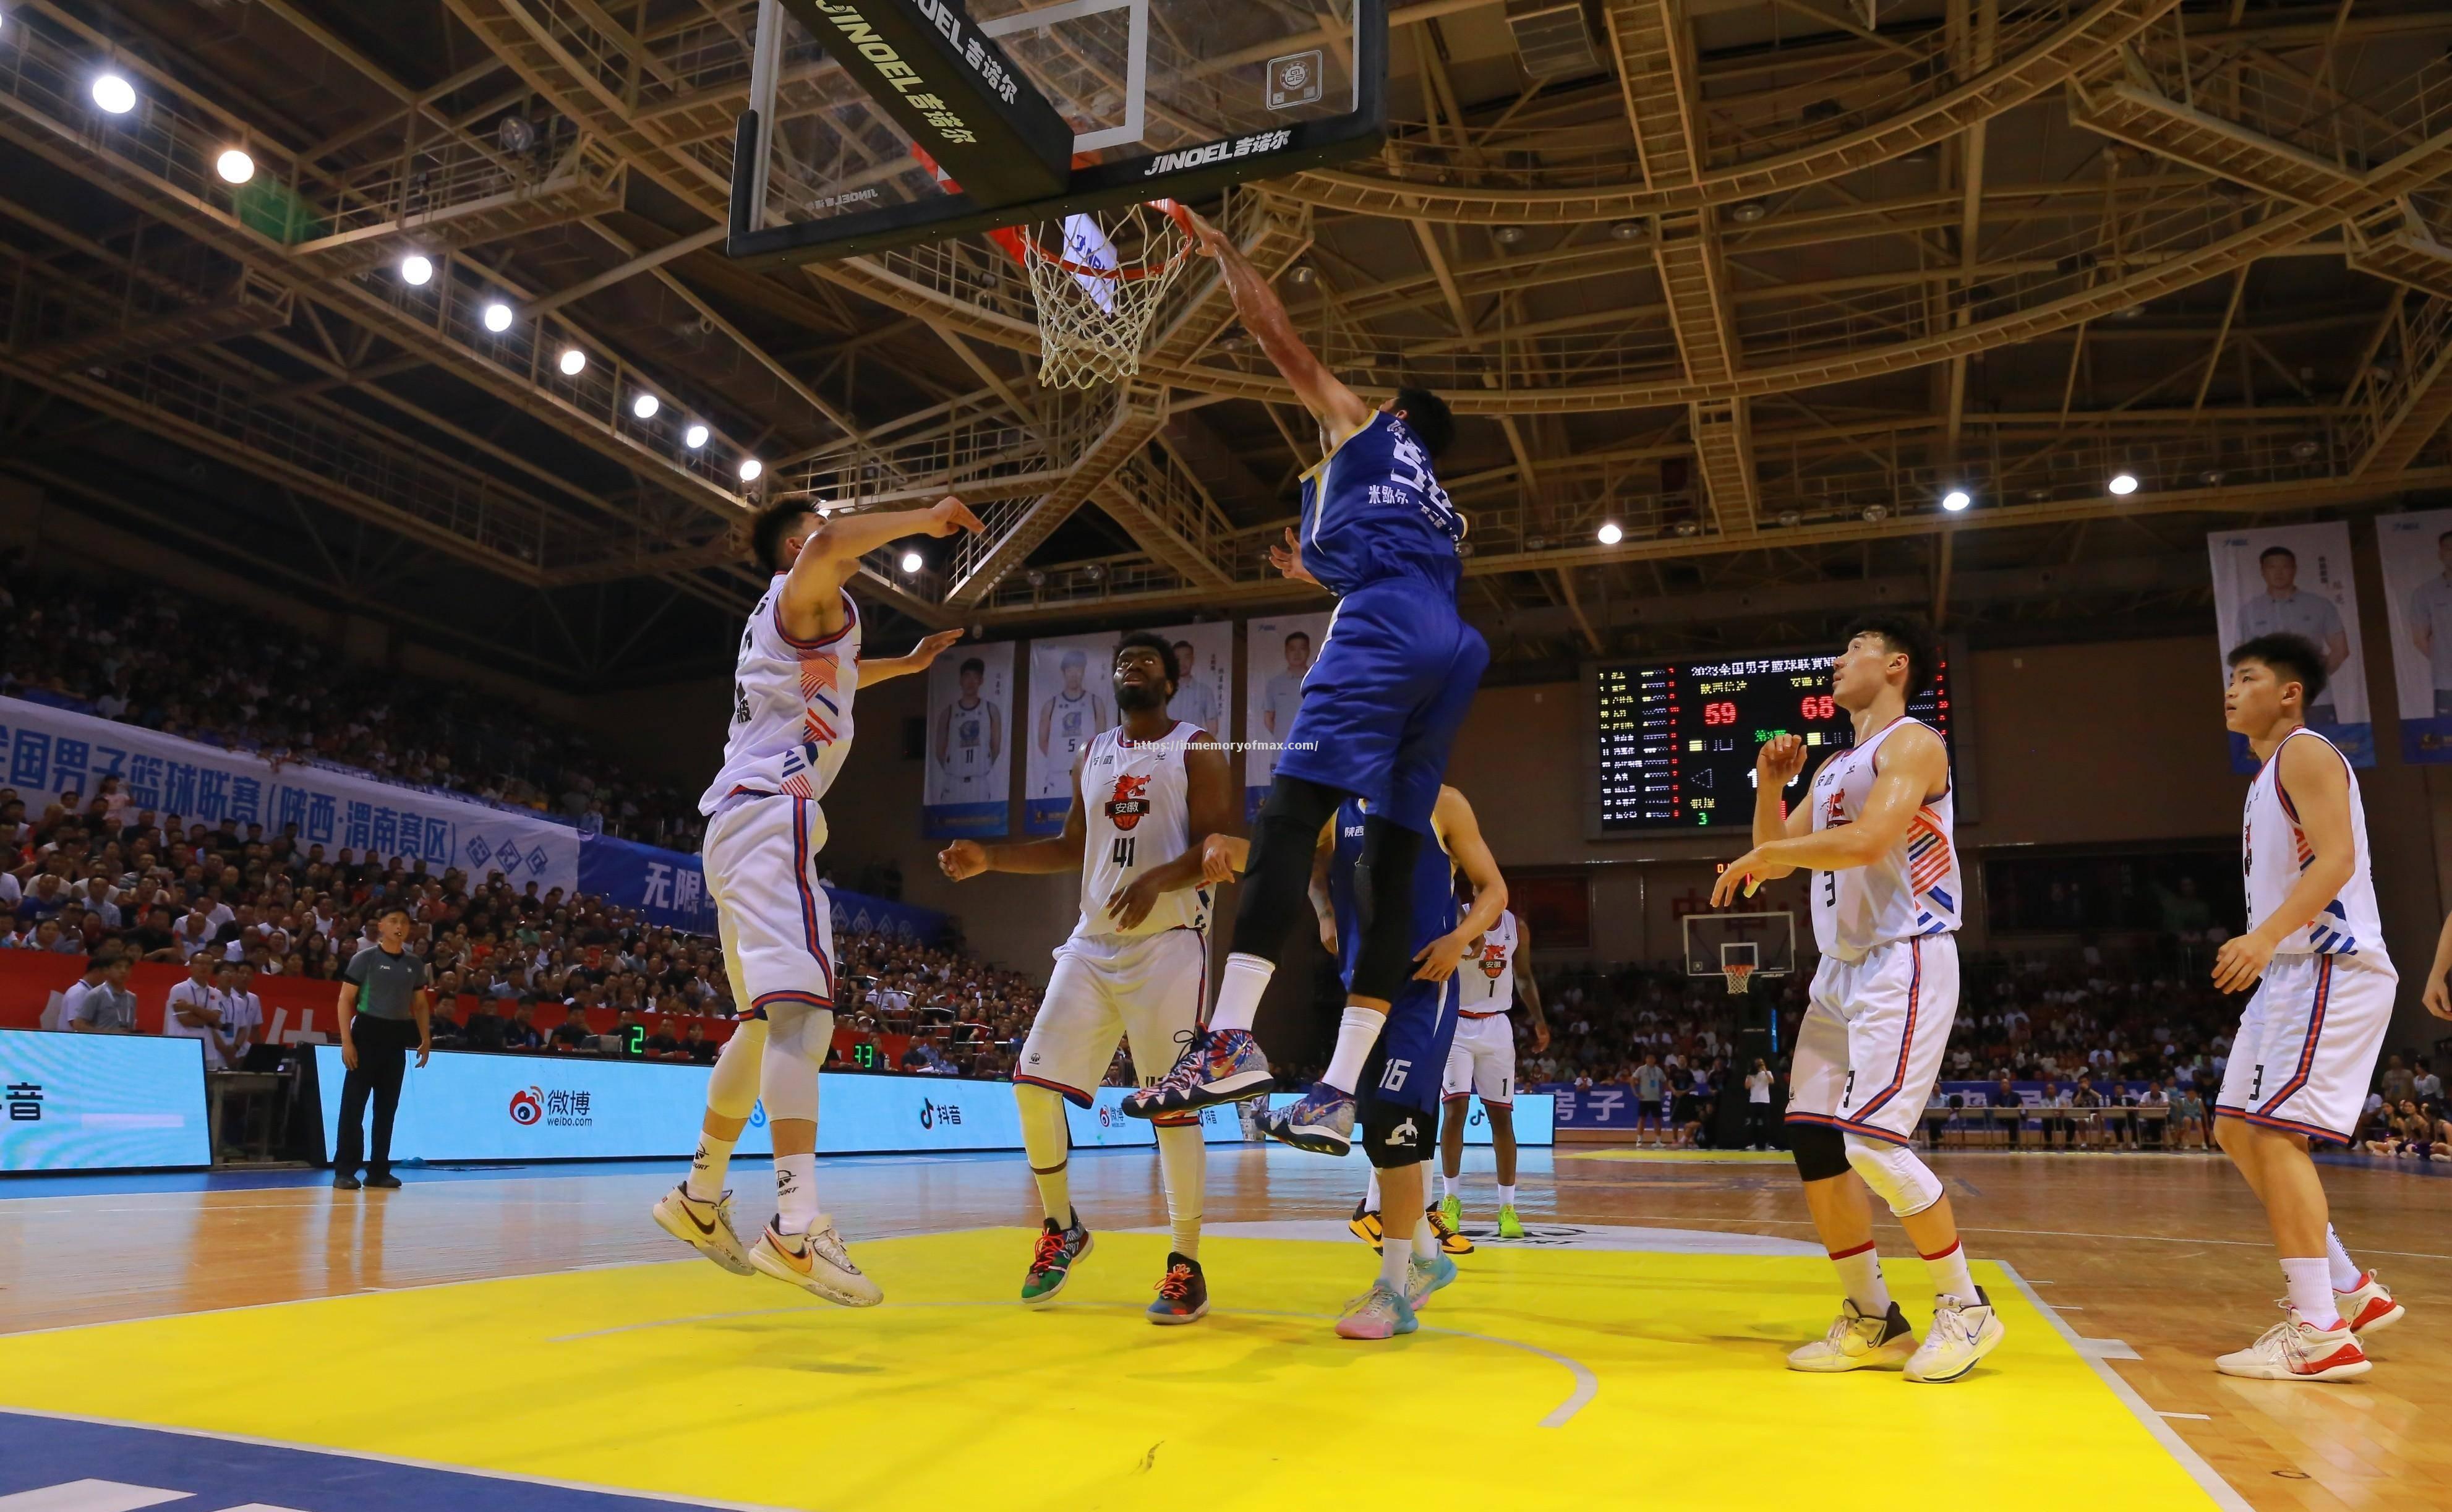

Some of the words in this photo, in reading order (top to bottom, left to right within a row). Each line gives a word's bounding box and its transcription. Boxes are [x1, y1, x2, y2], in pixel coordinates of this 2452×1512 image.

[912, 0, 963, 54] OEL
[965, 37, 1018, 105] 吉诺尔
[816, 0, 923, 93] JINOEL
[905, 93, 977, 143] 吉诺尔
[1144, 142, 1232, 176] JINOEL
[1234, 130, 1291, 157] 吉诺尔
[1368, 484, 1409, 505] 米歇尔
[1691, 656, 1839, 677] 2023全国男子篮球联赛N
[1704, 702, 1736, 725] 59
[1801, 695, 1835, 720] 68
[1067, 738, 1076, 752] 5
[1114, 801, 1139, 814] 安徽
[1698, 812, 1707, 825] 3
[1344, 826, 1364, 838] 陕西
[1113, 836, 1135, 868] 41
[642, 861, 716, 915] 无限
[1824, 870, 1836, 908] 3
[1489, 980, 1495, 997] 1
[631, 1026, 643, 1053] 2
[1378, 1057, 1412, 1092] 16
[2249, 1064, 2264, 1101] 3
[1502, 1078, 1508, 1097] 1
[1843, 1070, 1855, 1108] 3
[0, 1082, 43, 1121] 音
[547, 1090, 591, 1116] 微博
[547, 1116, 592, 1127] weibo.com
[936, 1104, 961, 1125] 抖音
[1204, 1109, 1218, 1124] 抖音
[693, 1161, 710, 1171] OURT
[777, 1186, 799, 1197] OURT
